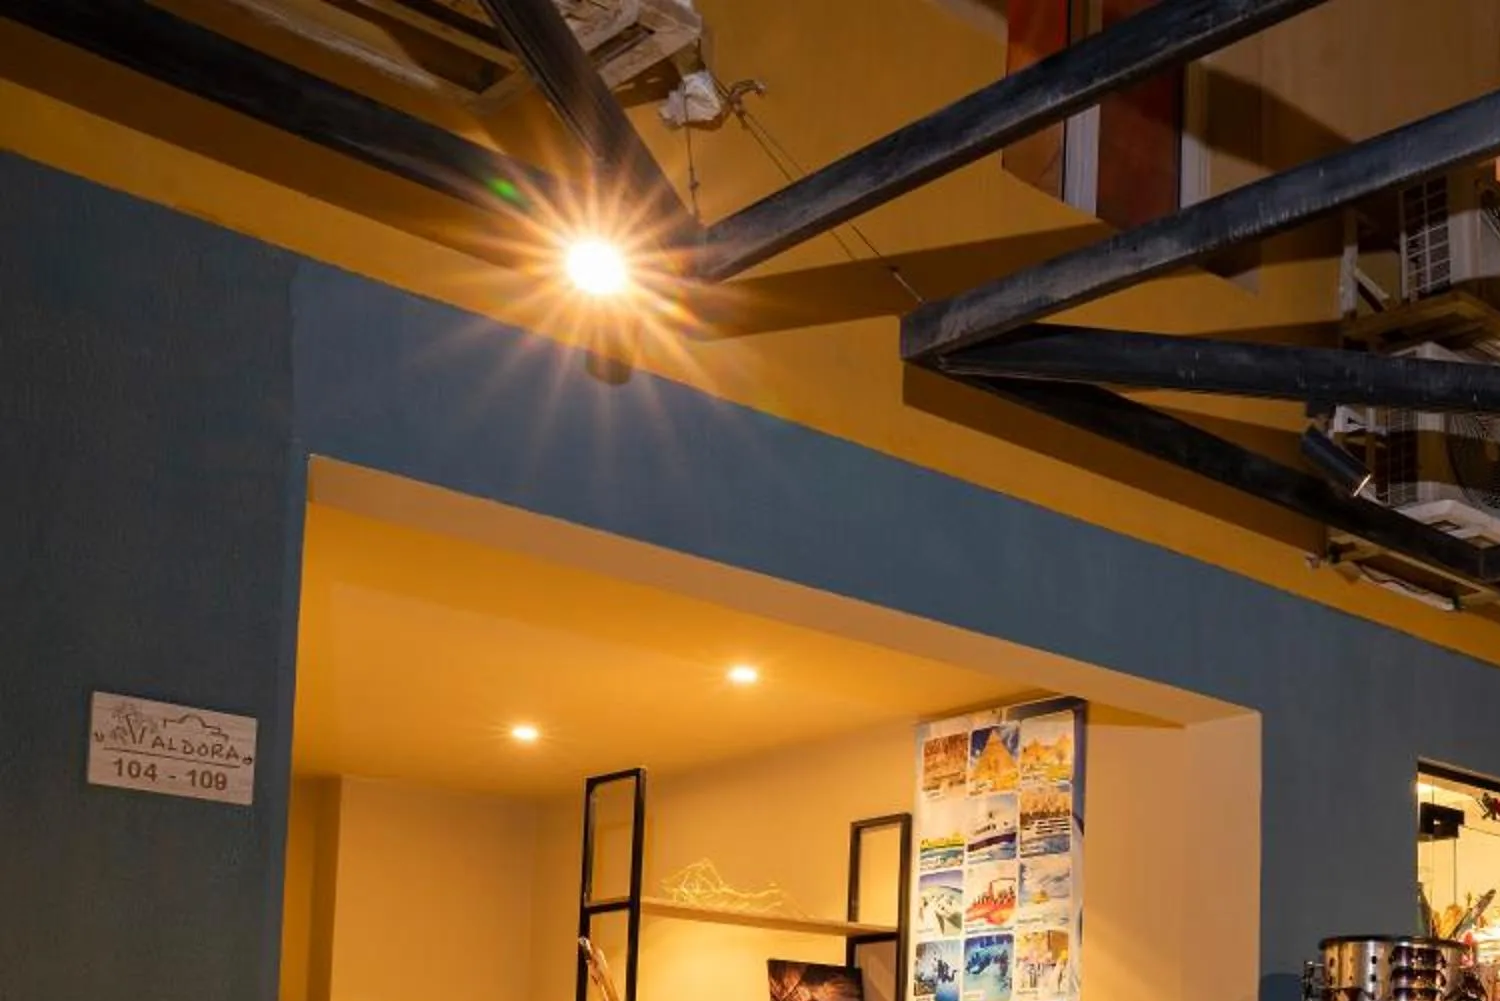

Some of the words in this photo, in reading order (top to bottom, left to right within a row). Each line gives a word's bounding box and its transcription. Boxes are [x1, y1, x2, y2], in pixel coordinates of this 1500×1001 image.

[124, 712, 241, 761] VALDORA
[113, 757, 158, 782] 104
[186, 768, 228, 791] 109
